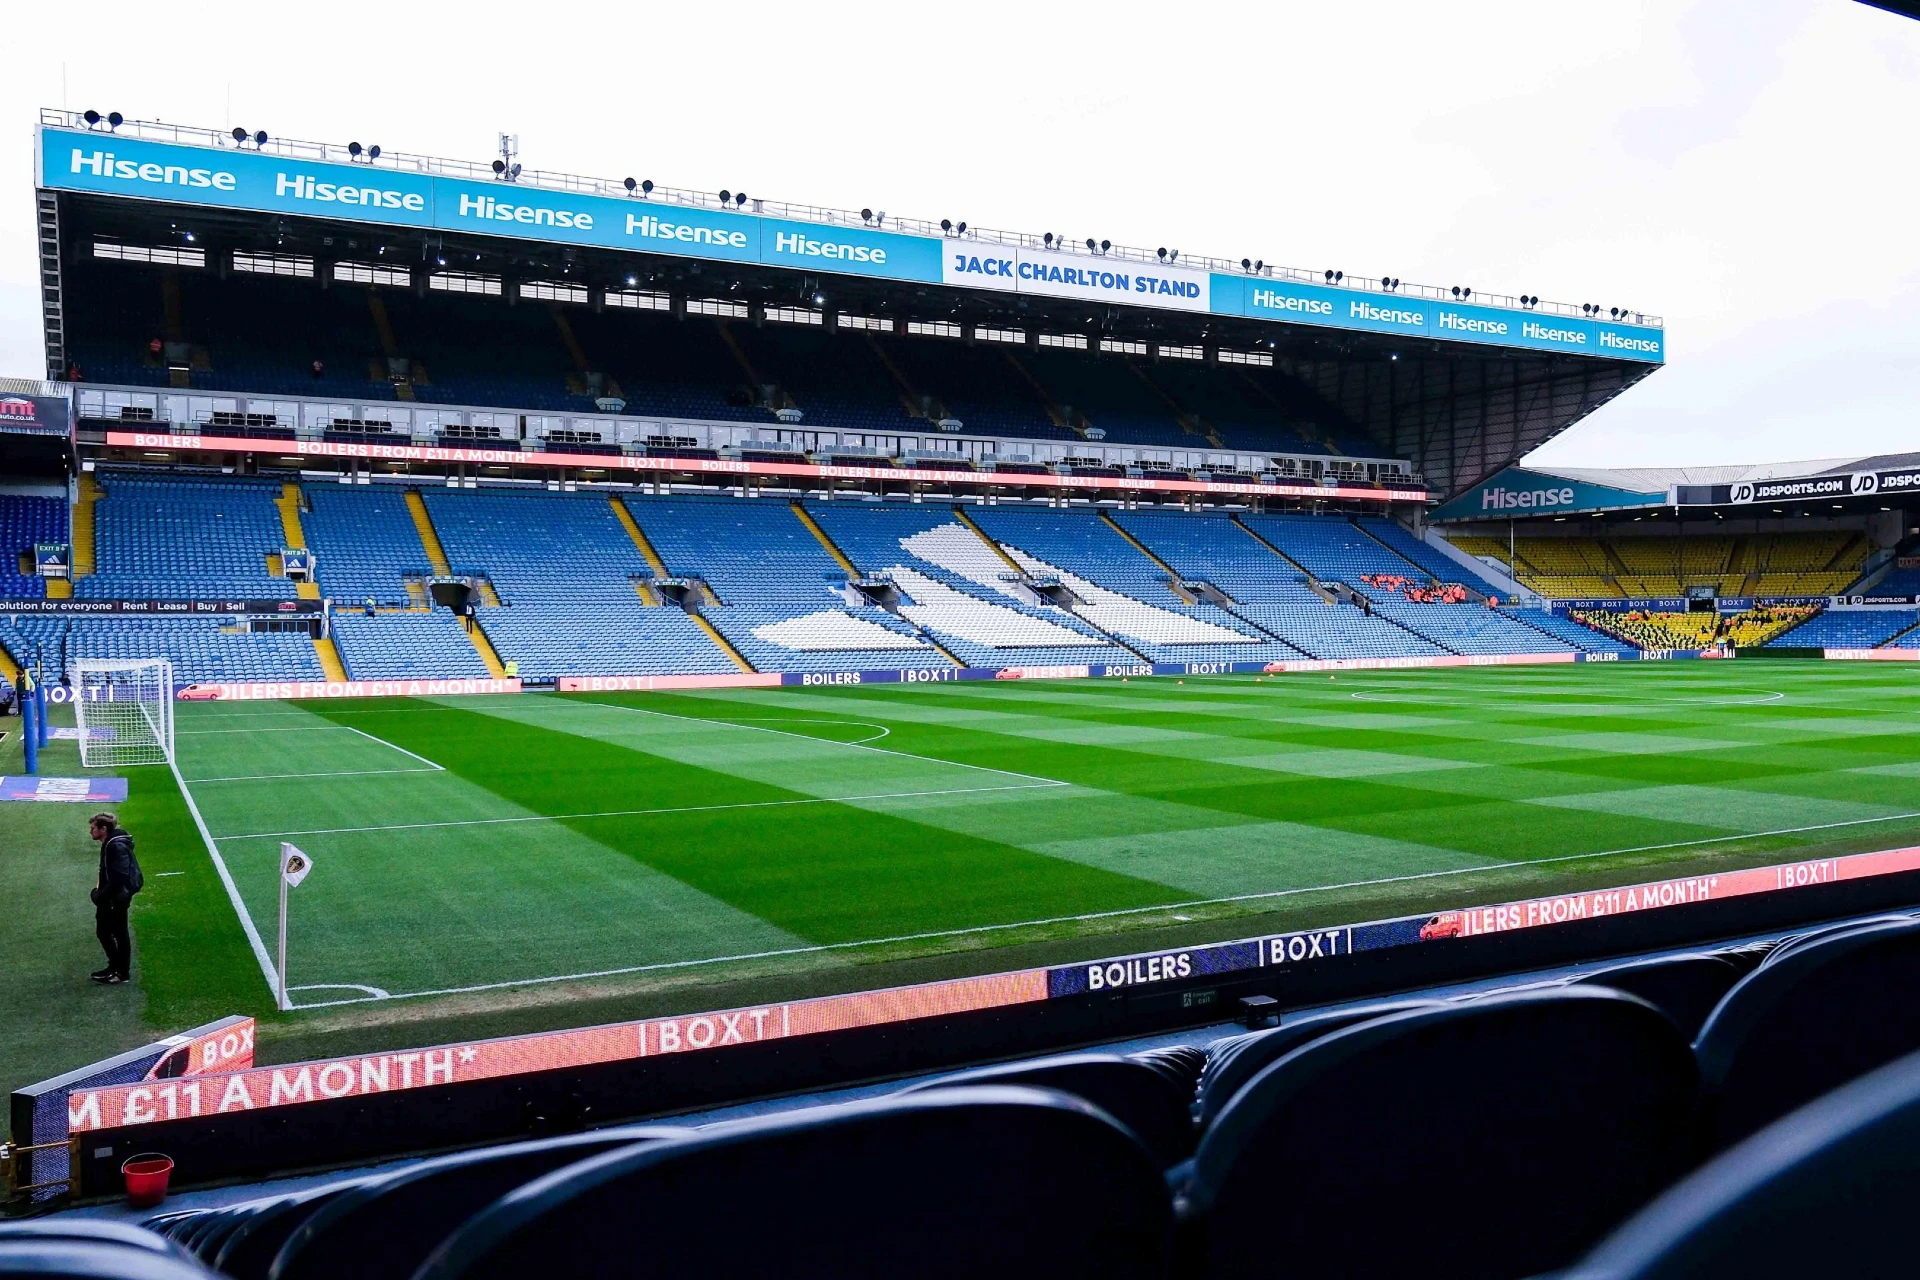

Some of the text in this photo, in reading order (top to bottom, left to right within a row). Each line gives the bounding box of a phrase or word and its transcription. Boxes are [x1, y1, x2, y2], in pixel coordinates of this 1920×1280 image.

[70, 148, 236, 191] Hisense
[275, 172, 425, 211] Hisense
[459, 193, 594, 231] Hisense
[625, 213, 747, 248] Hisense
[776, 231, 887, 264] Hisense
[955, 254, 1200, 298] JACK CHARLTON STAND
[1253, 289, 1333, 315] Hisense
[1349, 300, 1424, 326] Hisense
[1439, 311, 1508, 336] Hisense
[1522, 322, 1586, 344] Hisense
[1600, 330, 1660, 353] Hisense
[135, 435, 201, 448] BOILERS
[298, 441, 367, 456] BOILERS
[373, 445, 420, 458] FROM
[429, 448, 449, 460] £11
[455, 450, 465, 460] A
[702, 460, 750, 472] BOILERS
[819, 465, 871, 478] BOILERS
[874, 468, 910, 479] FROM
[914, 469, 931, 480] £11
[934, 471, 942, 481] A
[1118, 478, 1155, 489] BOILERS
[1207, 482, 1246, 493] BOILERS
[1251, 484, 1276, 494] FROM
[1279, 485, 1293, 494] £11
[1295, 486, 1303, 495] A
[1756, 480, 1843, 497] JDSPORTS.COM
[1482, 487, 1574, 510] Hisense
[41, 602, 58, 611] for
[60, 603, 112, 613] everyone
[122, 602, 148, 611] Rent
[157, 602, 188, 611] Lease
[197, 602, 217, 613] Buy
[226, 602, 245, 611] Sell
[1586, 653, 1618, 662] BOILERS
[803, 672, 861, 685] BOILERS
[1105, 665, 1153, 676] BOILERS
[302, 684, 365, 699] FROM
[372, 682, 401, 697] £11
[407, 682, 422, 696] A
[1527, 896, 1587, 927] FROM
[1593, 893, 1620, 917] £11
[1625, 891, 1638, 912] A
[1088, 954, 1192, 990] BOILERS
[123, 1082, 198, 1124] £11
[218, 1076, 254, 1113] A
